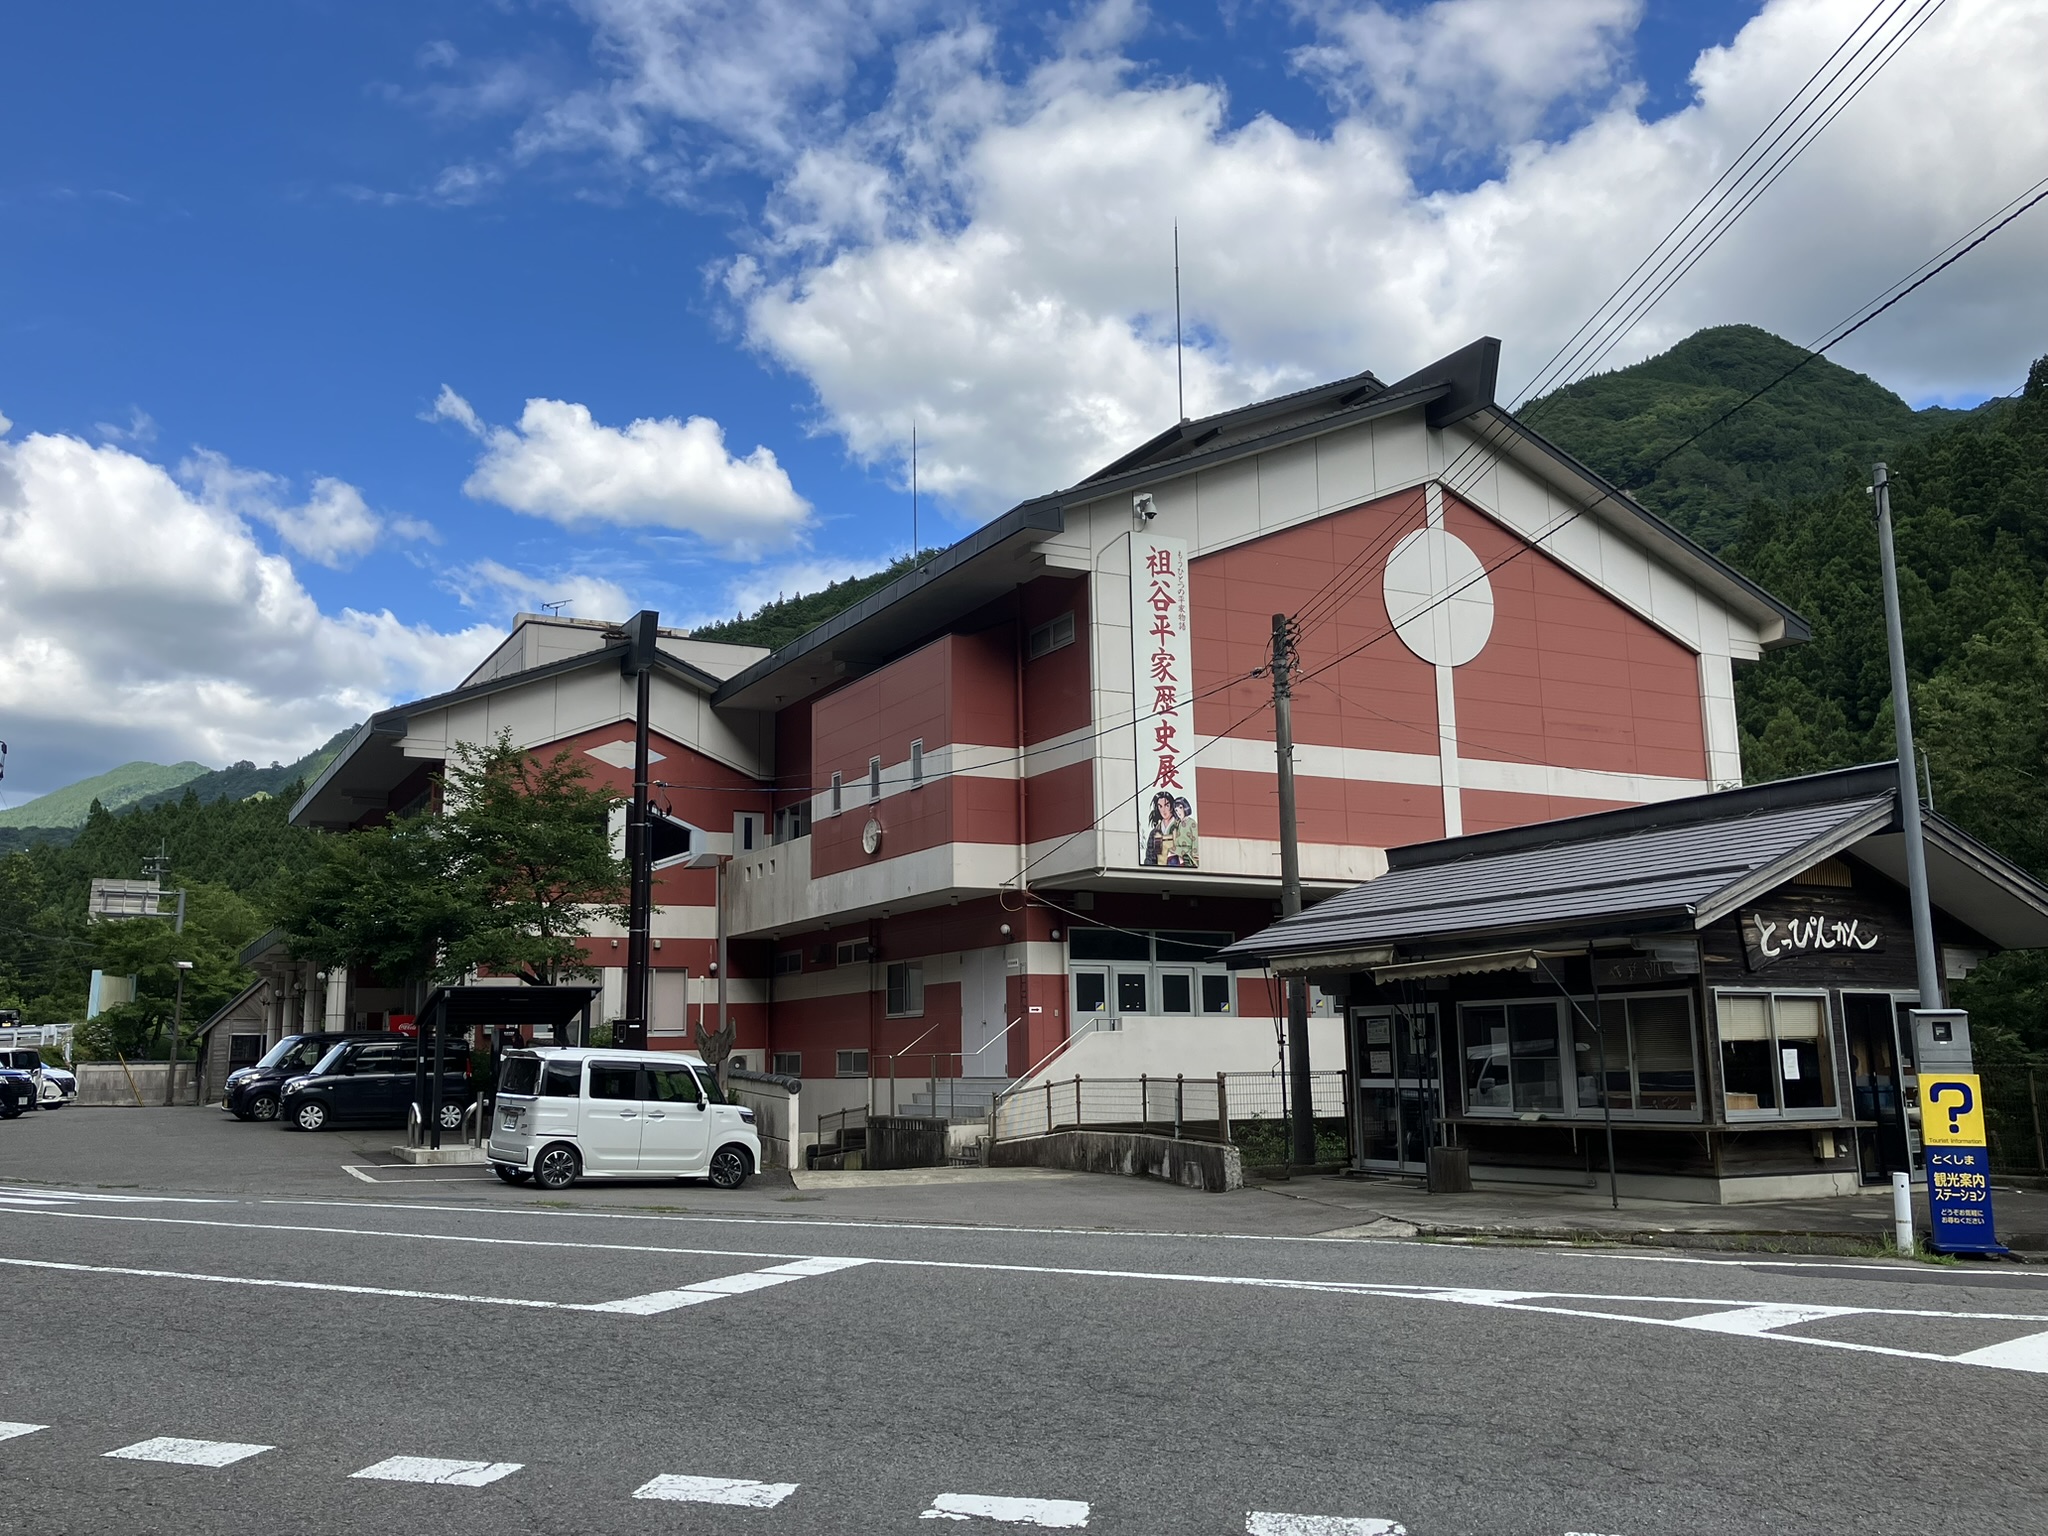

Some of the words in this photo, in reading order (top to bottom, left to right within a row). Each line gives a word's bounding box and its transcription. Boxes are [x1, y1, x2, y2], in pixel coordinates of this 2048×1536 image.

[1146, 545, 1183, 790] 祖谷平家歴史展
[1753, 913, 1878, 957] とっぴんかん
[1932, 1154, 1975, 1165] とくしま
[1933, 1172, 1985, 1188] 観光案内
[1935, 1188, 1986, 1201] ステーション
[1941, 1208, 1984, 1217] どうぞお気軽に
[1941, 1216, 1985, 1225] お尋ねください
